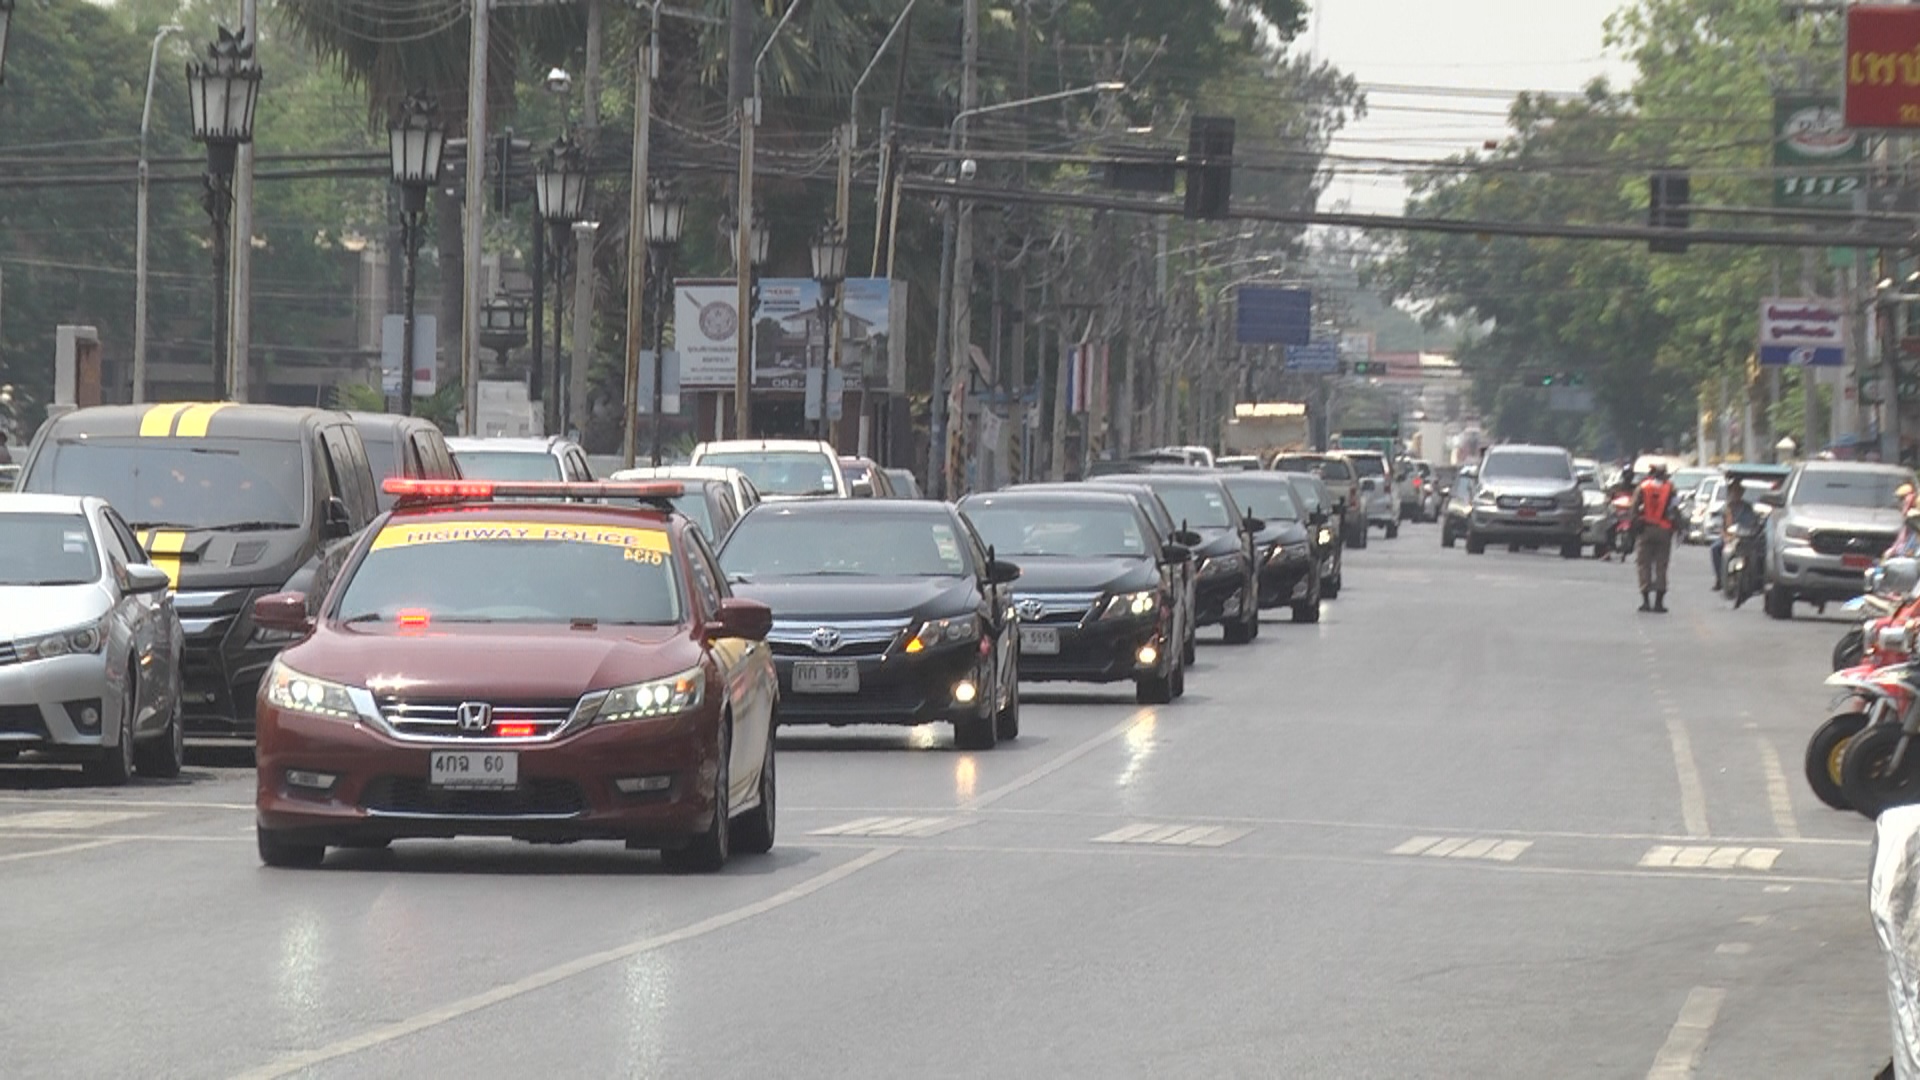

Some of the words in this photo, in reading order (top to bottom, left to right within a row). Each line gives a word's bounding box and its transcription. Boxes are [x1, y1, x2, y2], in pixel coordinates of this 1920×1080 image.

[1784, 177, 1859, 194] 1112
[407, 529, 529, 542] HIGHWAY
[543, 529, 641, 547] POLICE
[435, 755, 470, 773] 4กฉ
[483, 755, 504, 773] 60
